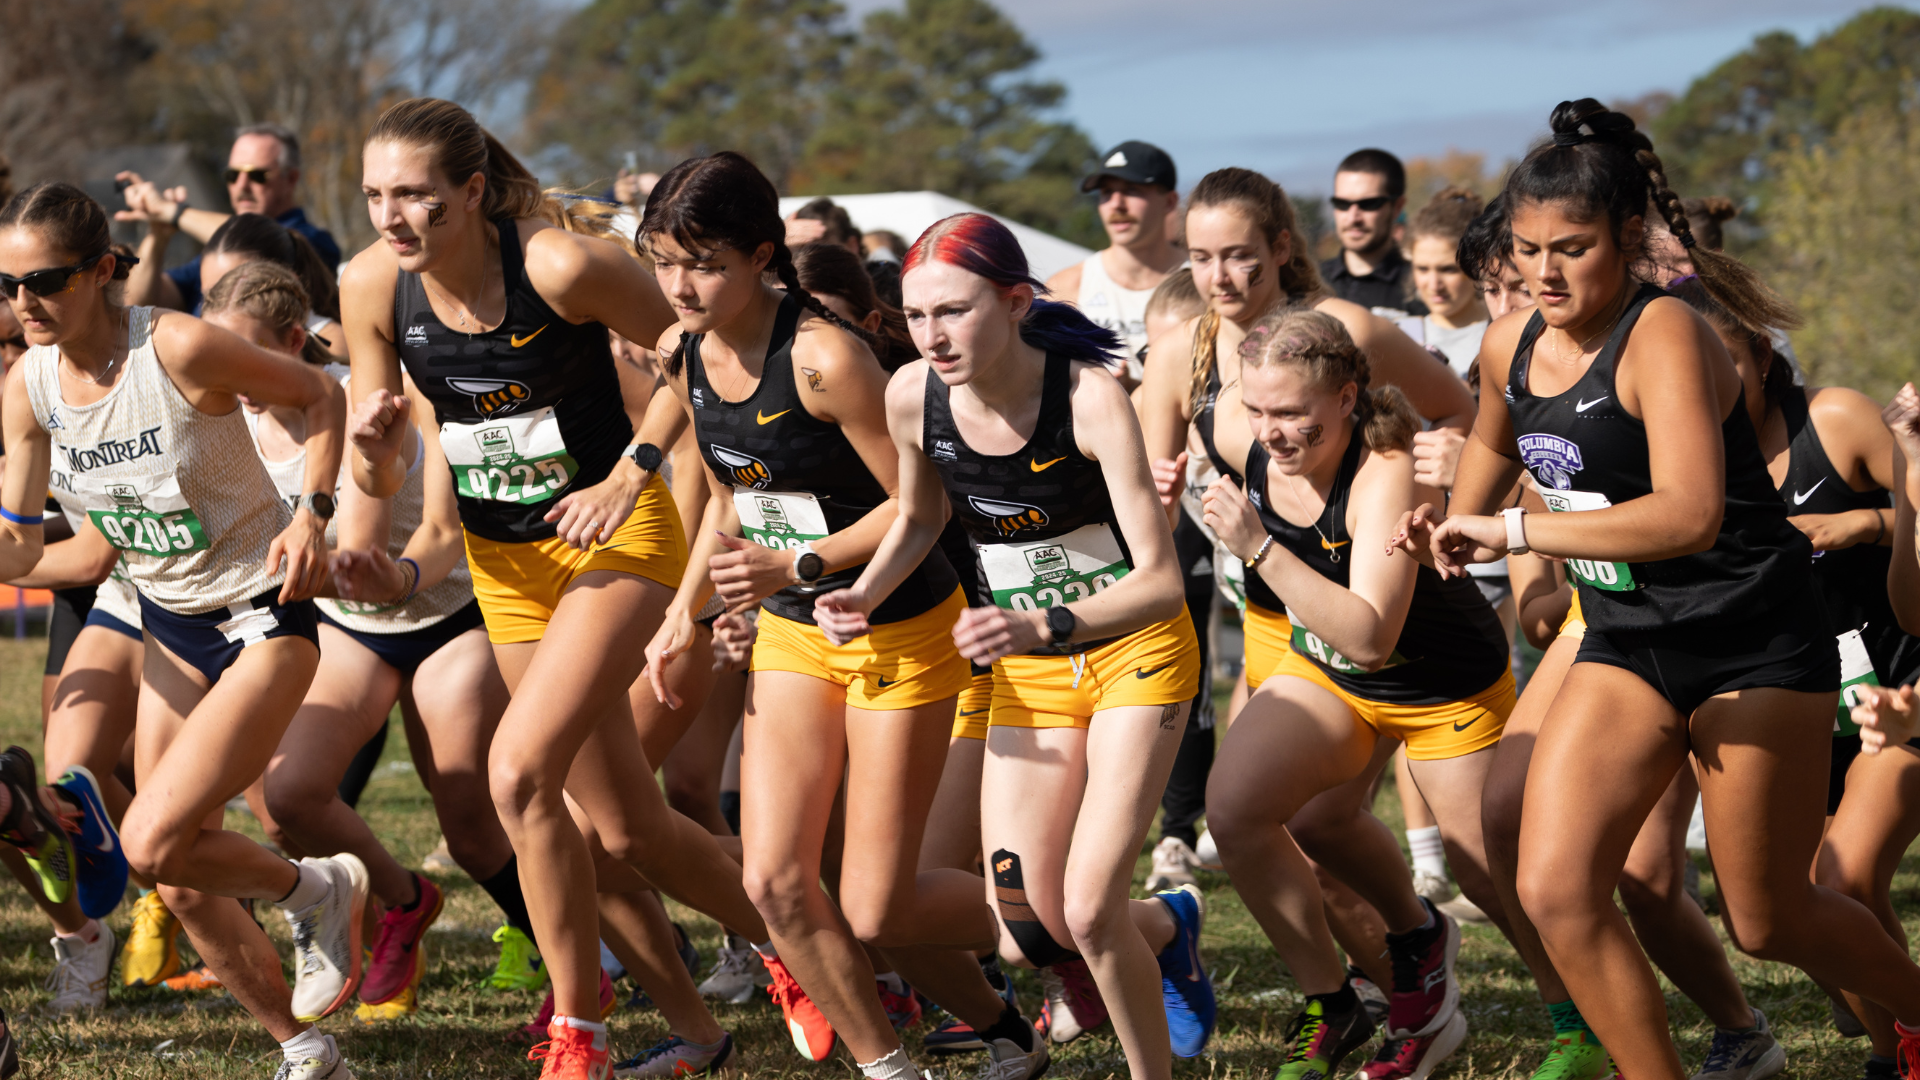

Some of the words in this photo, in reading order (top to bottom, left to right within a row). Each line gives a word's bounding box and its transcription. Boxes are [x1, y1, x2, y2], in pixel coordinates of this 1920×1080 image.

[407, 326, 425, 335] AAC
[483, 430, 503, 441] AAC
[936, 440, 953, 451] AAC
[1518, 436, 1579, 464] COLUMBIA
[1532, 451, 1561, 461] COLLEGE
[467, 457, 569, 502] 9225
[101, 513, 195, 553] 9205
[1035, 548, 1057, 559] AAC
